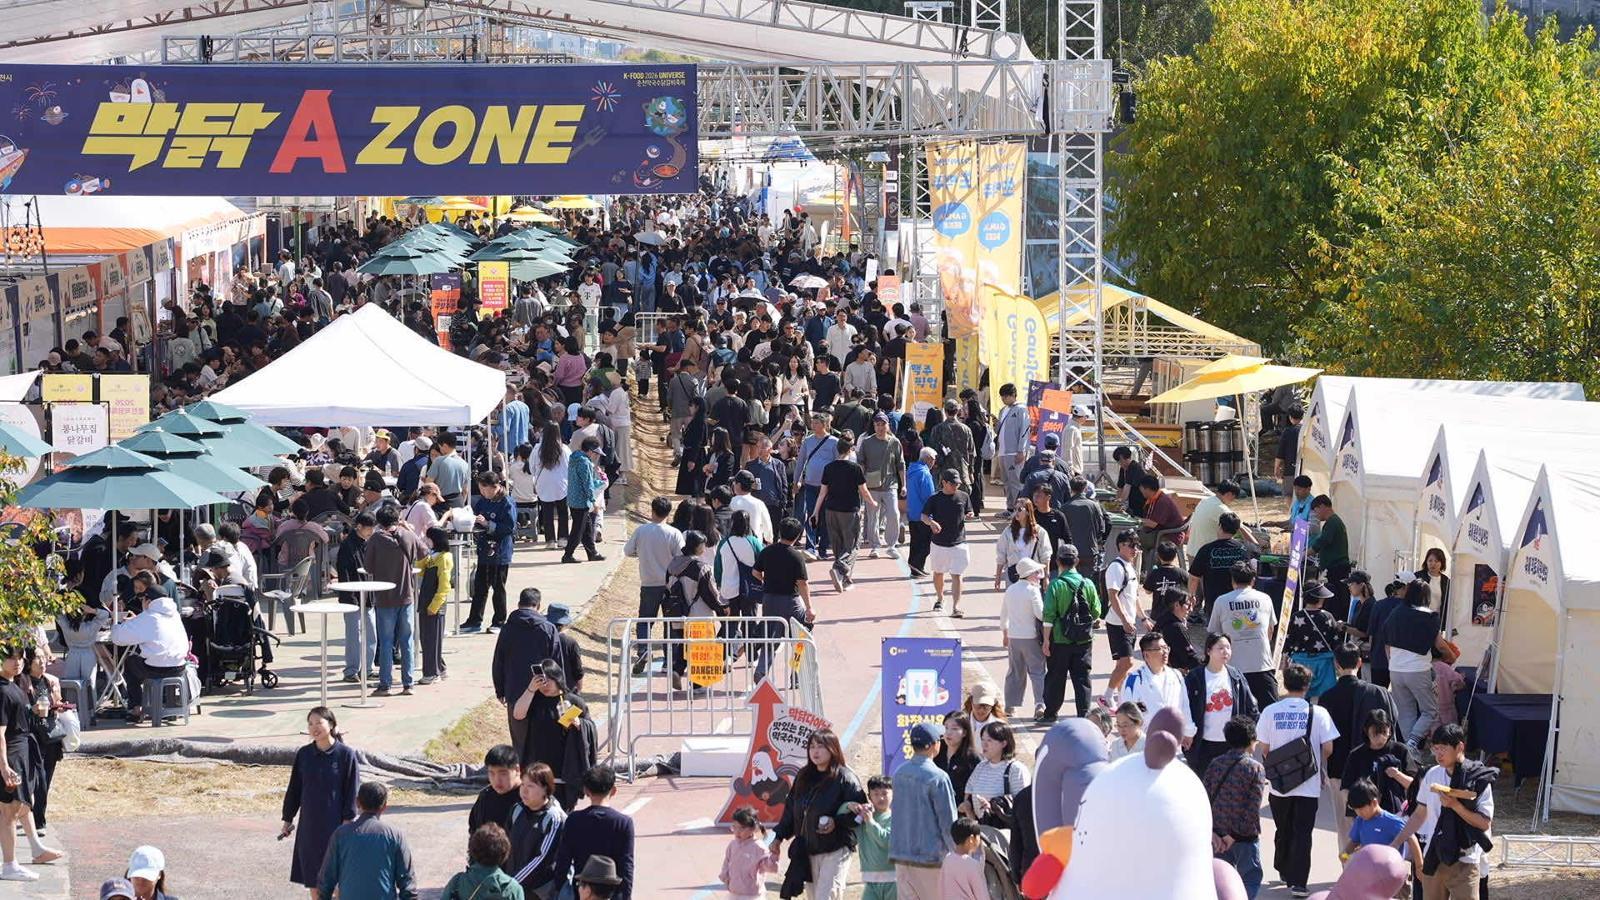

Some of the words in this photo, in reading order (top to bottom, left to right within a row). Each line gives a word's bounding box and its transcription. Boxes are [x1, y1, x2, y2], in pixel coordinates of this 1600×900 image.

[80, 102, 281, 172] 막닭
[269, 89, 347, 174] A
[355, 105, 586, 164] ZONE
[911, 364, 932, 376] 맥주
[915, 377, 938, 390] 픽업
[67, 435, 93, 445] 닭갈비
[1229, 600, 1260, 611] Umbro
[691, 666, 722, 674] DANGER!
[773, 722, 797, 733] 맛있는
[772, 732, 800, 746] 막국수가
